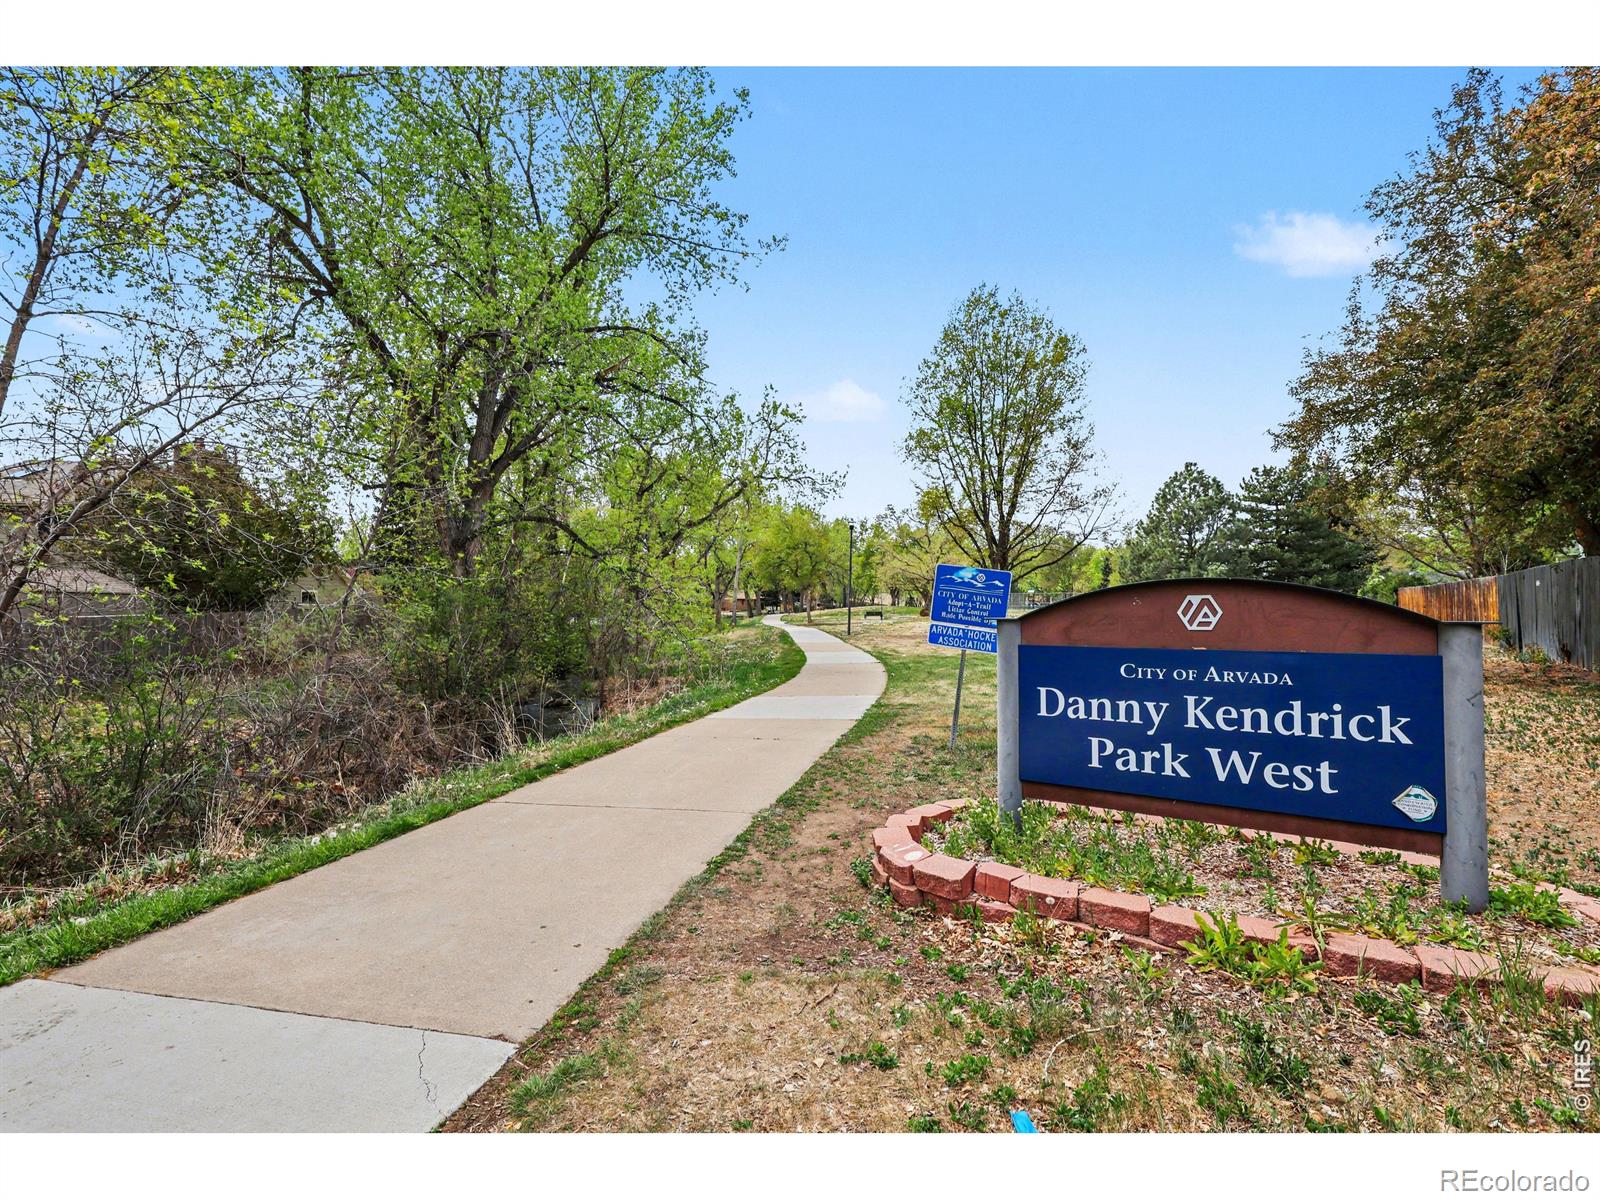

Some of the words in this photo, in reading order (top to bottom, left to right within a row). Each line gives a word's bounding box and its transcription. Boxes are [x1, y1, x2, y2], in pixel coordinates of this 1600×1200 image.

[937, 590, 955, 598] CITY
[972, 595, 1002, 604] ARVADA
[967, 608, 989, 616] Control
[931, 625, 963, 637] ARVADA
[967, 630, 996, 642] HOCKE
[937, 636, 992, 651] ASSOCIATION
[1119, 662, 1167, 681] CITY
[1204, 666, 1294, 687] ARVADA
[1036, 686, 1170, 735] Danny
[1183, 694, 1413, 745] Kendrick
[1087, 737, 1191, 779] Park
[1205, 747, 1339, 795] West
